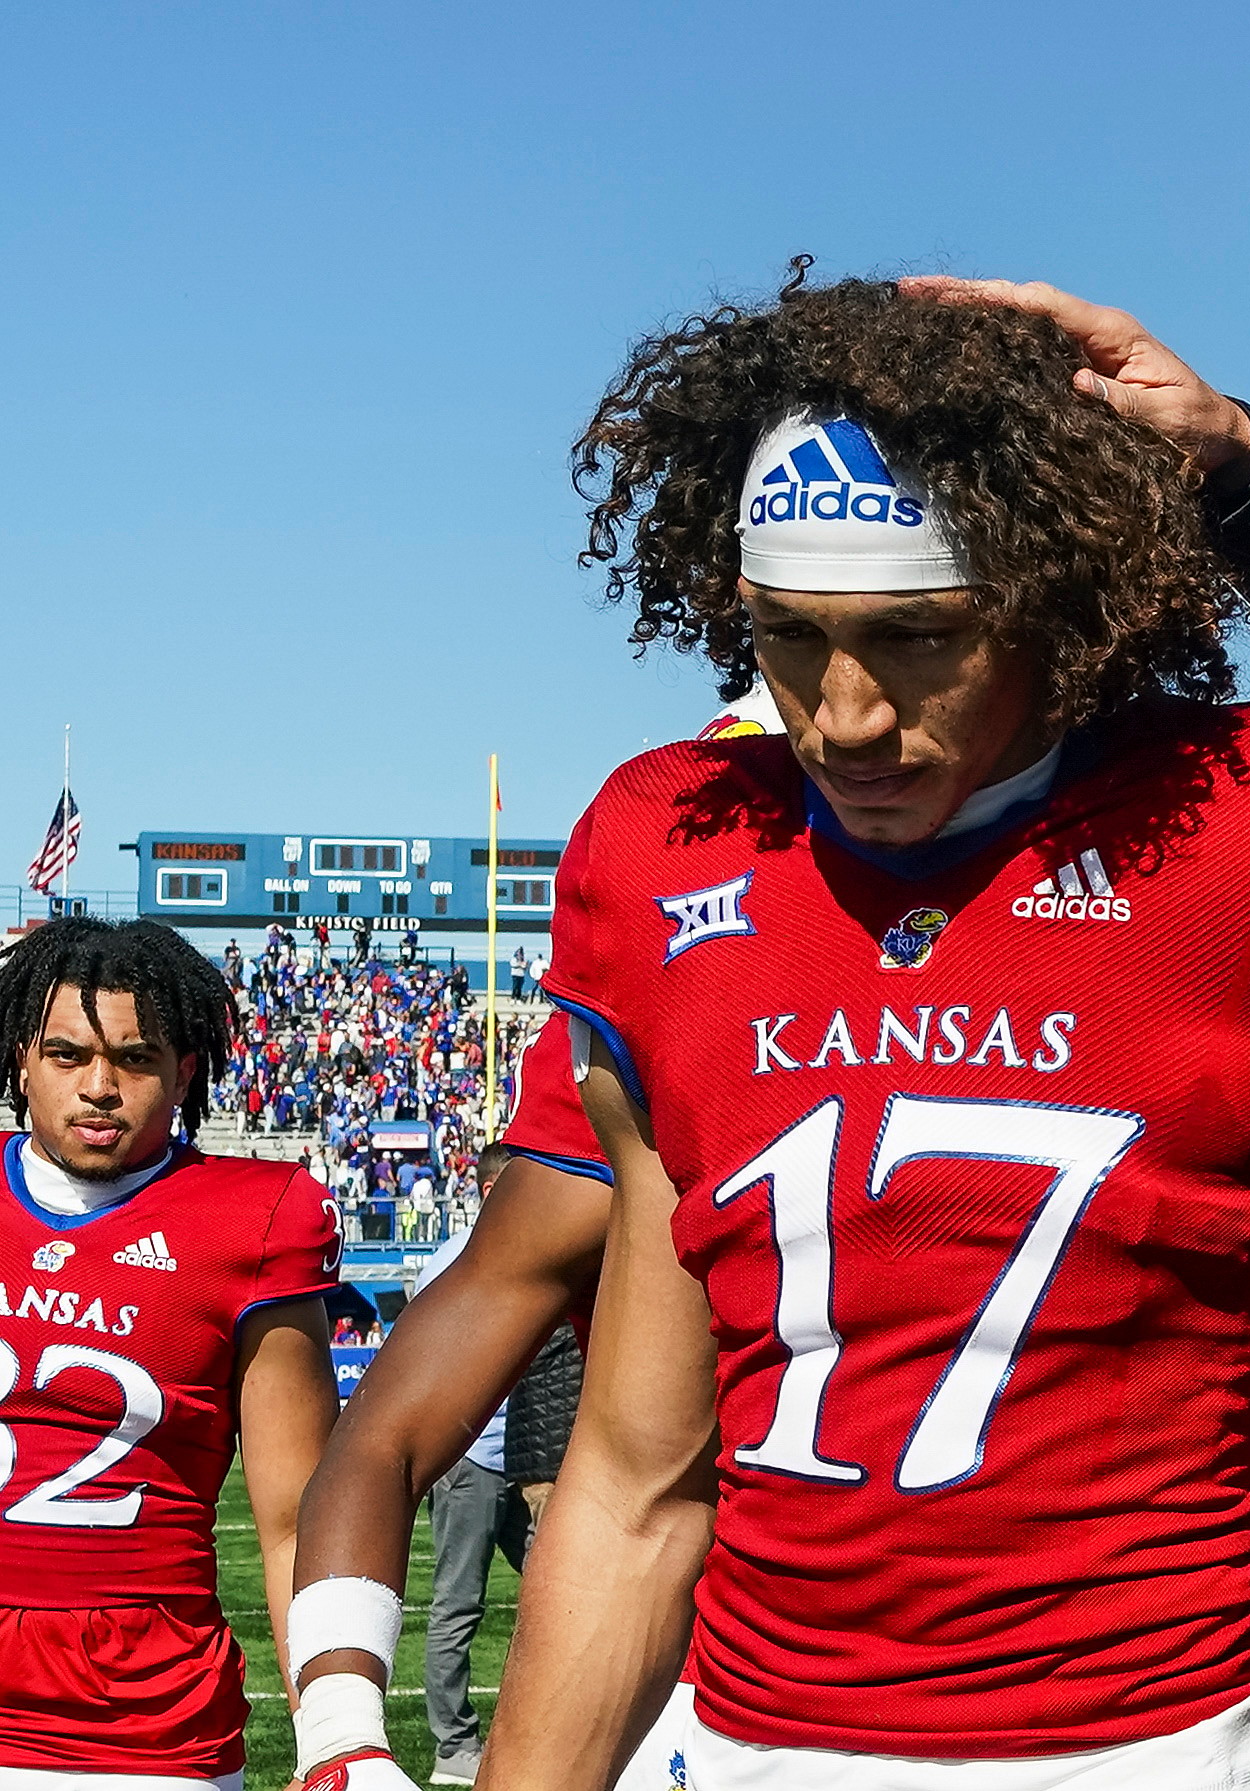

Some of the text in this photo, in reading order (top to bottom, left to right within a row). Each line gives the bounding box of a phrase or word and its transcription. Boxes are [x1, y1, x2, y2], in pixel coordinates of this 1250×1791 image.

[749, 481, 924, 527] adidas
[155, 843, 239, 860] KANSAS
[264, 878, 310, 892] BALL ON
[327, 880, 361, 894] DOWN
[380, 880, 395, 894] TO
[1011, 892, 1132, 922] adidas
[373, 917, 421, 931] FIELD
[750, 1004, 1079, 1076] KANSAS
[112, 1251, 178, 1272] adidas
[712, 1090, 1147, 1495] 17
[0, 1336, 165, 1529] 2
